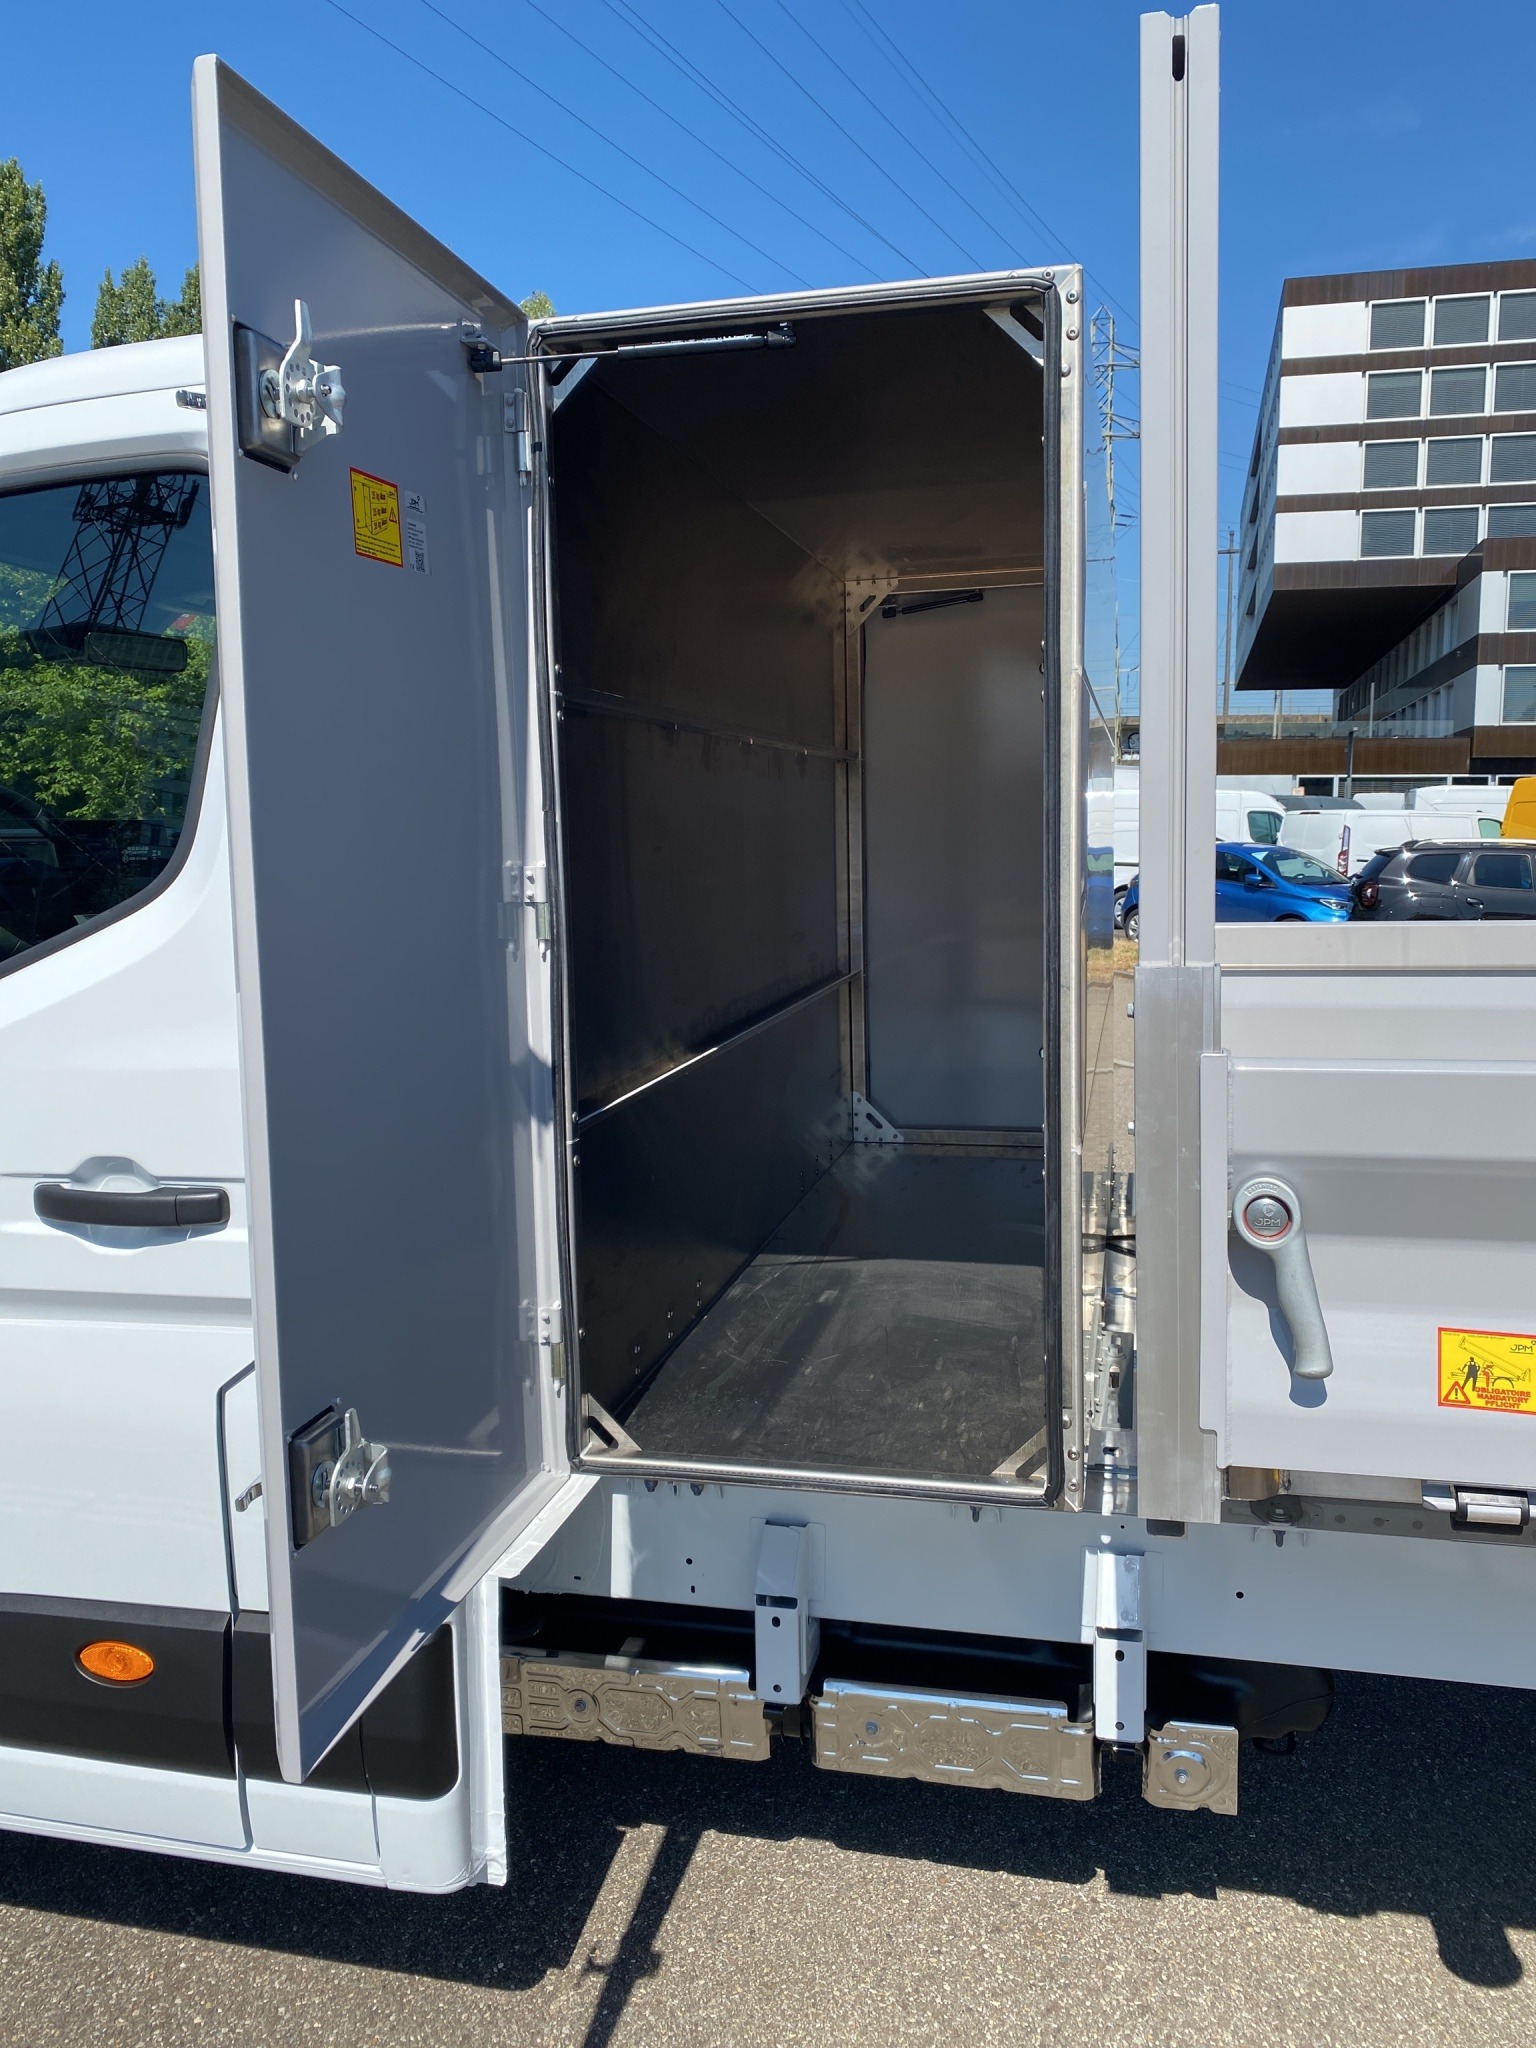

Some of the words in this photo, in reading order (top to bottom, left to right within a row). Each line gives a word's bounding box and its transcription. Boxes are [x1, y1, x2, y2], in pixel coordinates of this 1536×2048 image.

[1254, 1218, 1281, 1226] JPM
[1510, 1344, 1533, 1353] JPM
[1475, 1386, 1532, 1398] OBLIGATOIRE
[1477, 1393, 1529, 1404] MANDATORY
[1485, 1400, 1521, 1409] PFLICHT
